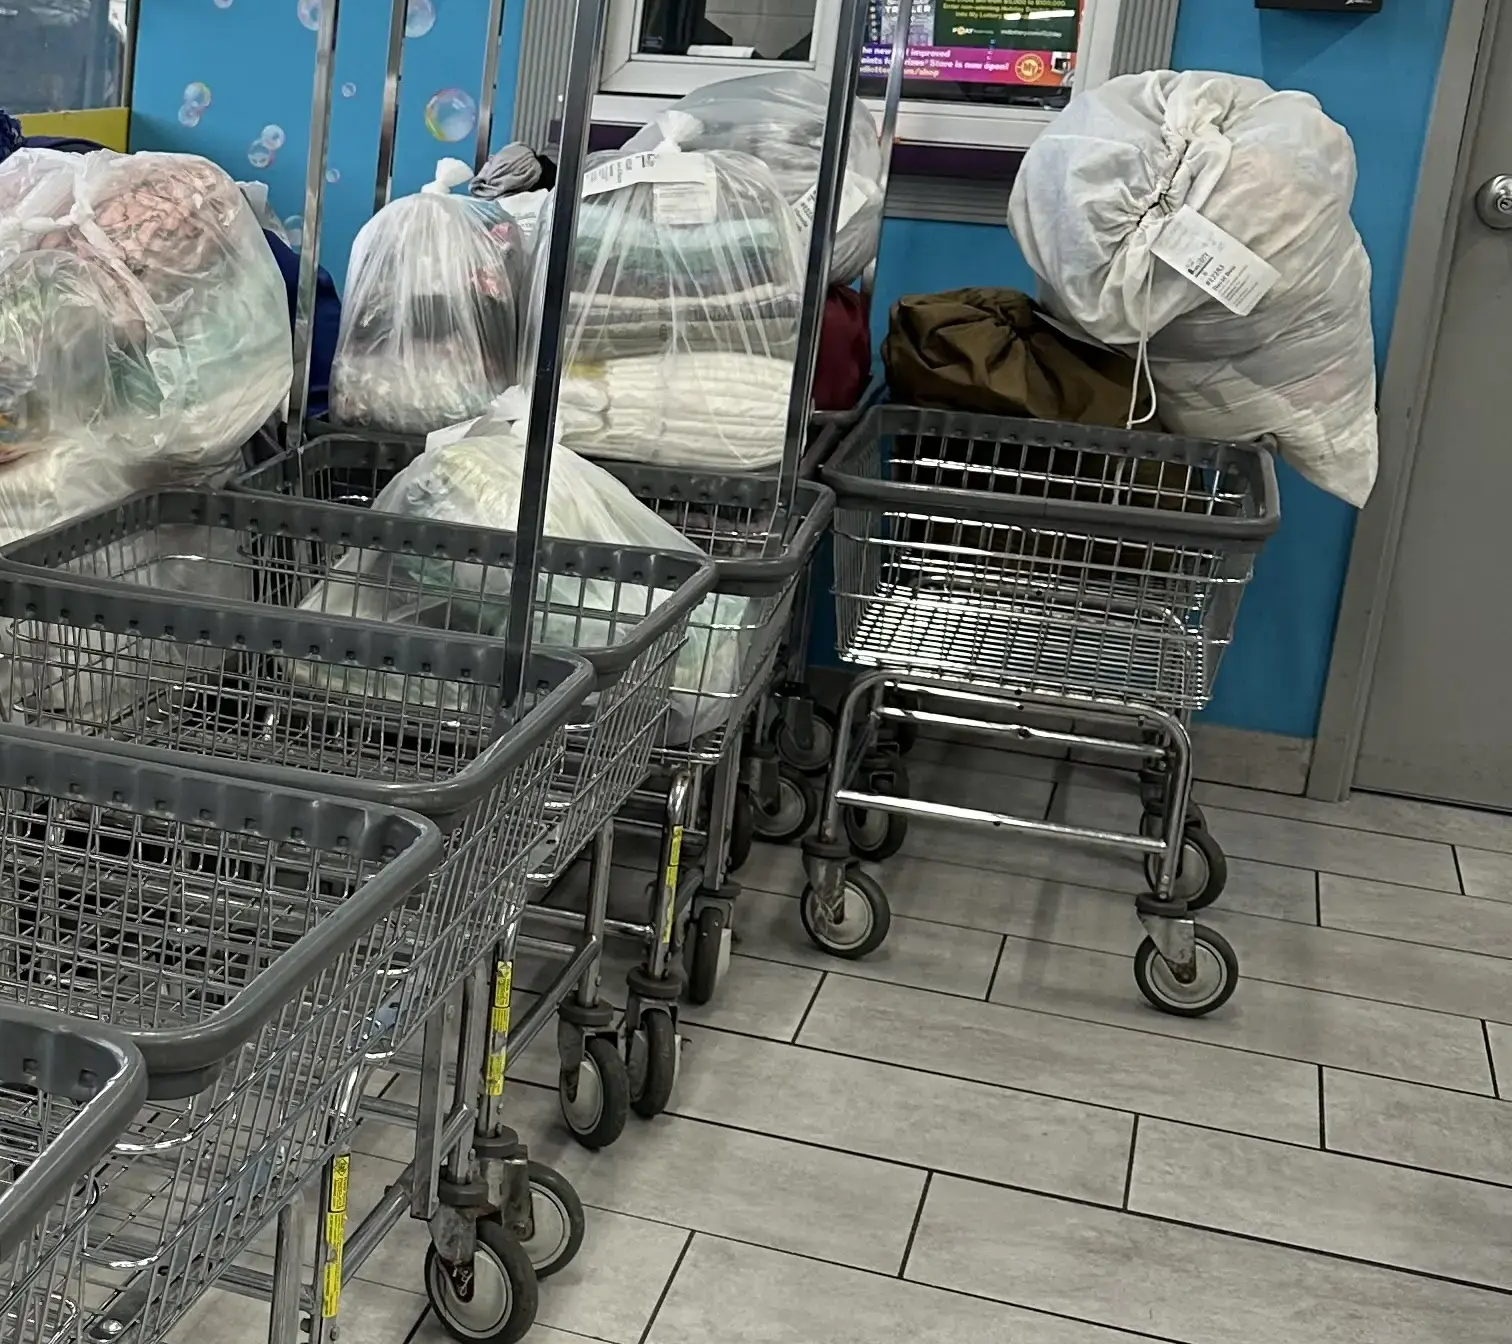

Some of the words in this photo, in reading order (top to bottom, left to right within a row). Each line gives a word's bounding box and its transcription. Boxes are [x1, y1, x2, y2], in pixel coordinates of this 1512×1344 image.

[911, 49, 951, 58] improved
[930, 60, 953, 69] Store
[955, 61, 963, 69] is
[964, 62, 983, 70] now
[984, 62, 1009, 72] open!
